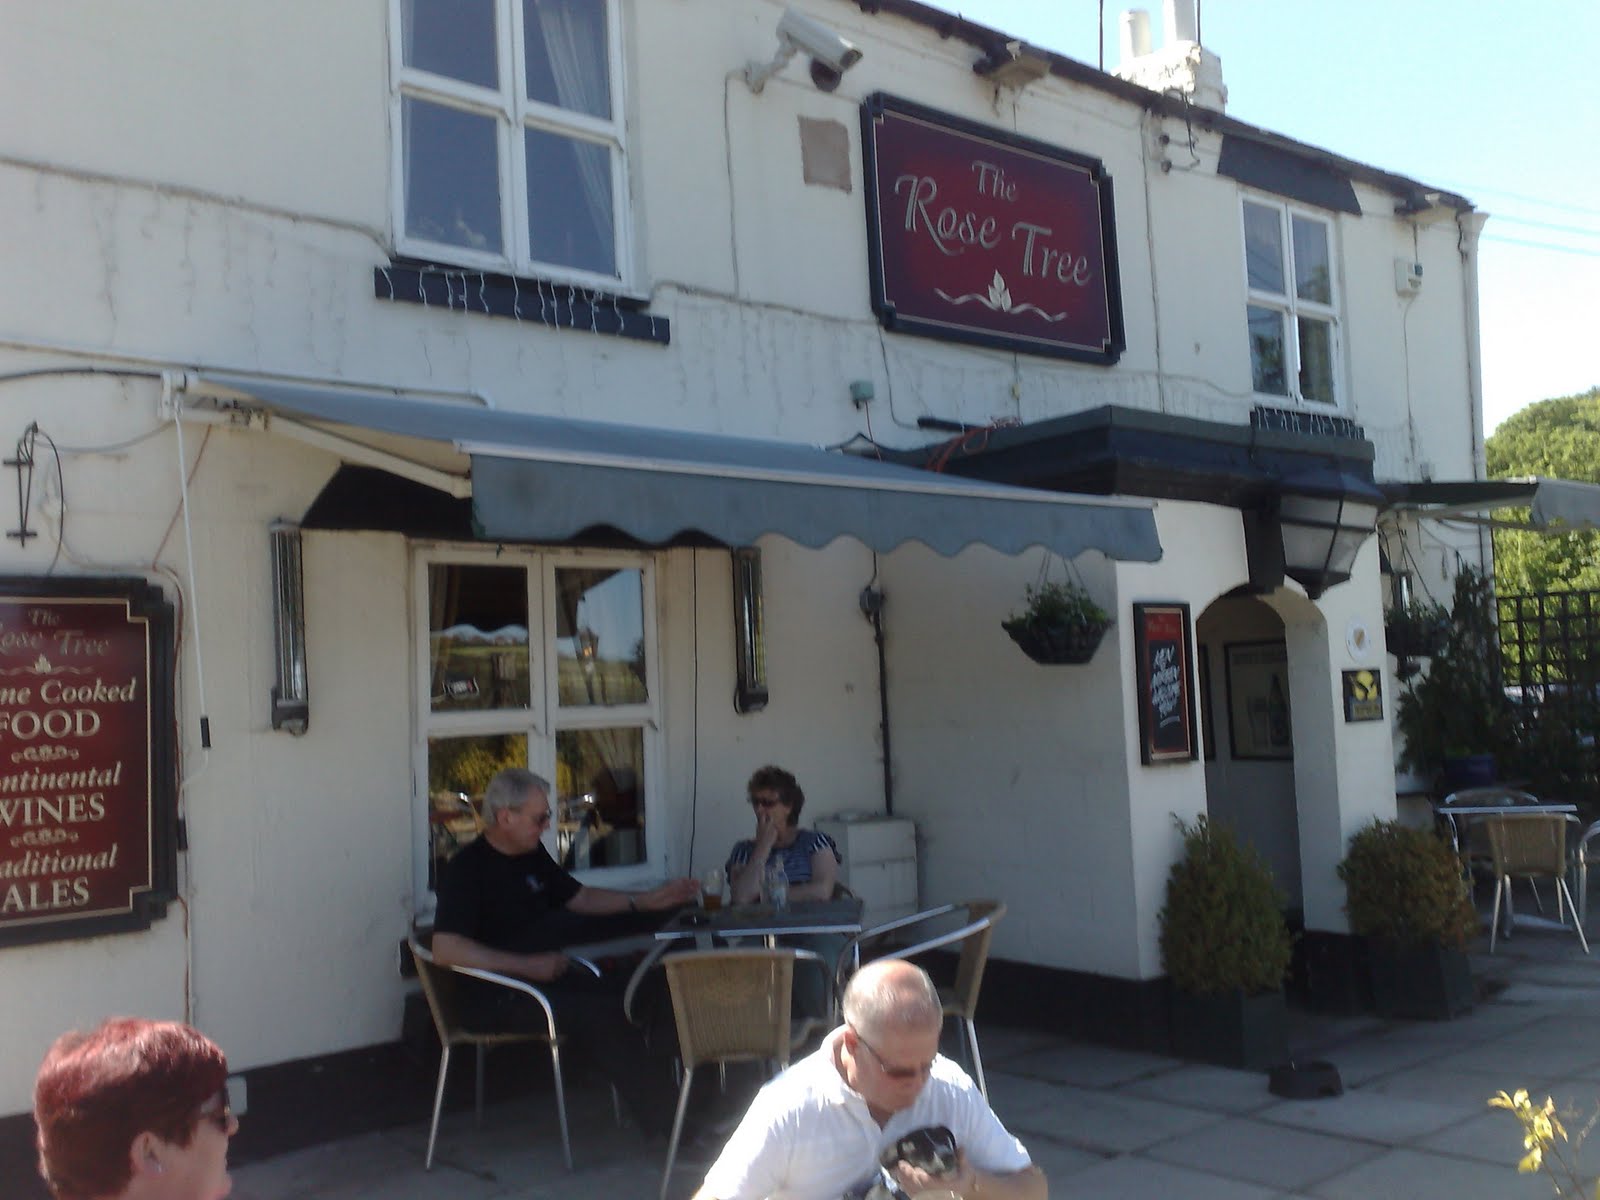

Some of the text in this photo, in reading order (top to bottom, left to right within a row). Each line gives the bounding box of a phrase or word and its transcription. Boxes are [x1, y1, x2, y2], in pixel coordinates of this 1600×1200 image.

[972, 160, 1018, 201] The
[895, 175, 1092, 286] Rose Tree
[28, 607, 60, 626] The
[0, 622, 110, 656] ose Tree
[40, 676, 137, 705] Cooked
[0, 760, 122, 793] ntinental
[0, 842, 118, 879] aditional
[2, 876, 90, 913] ALES
